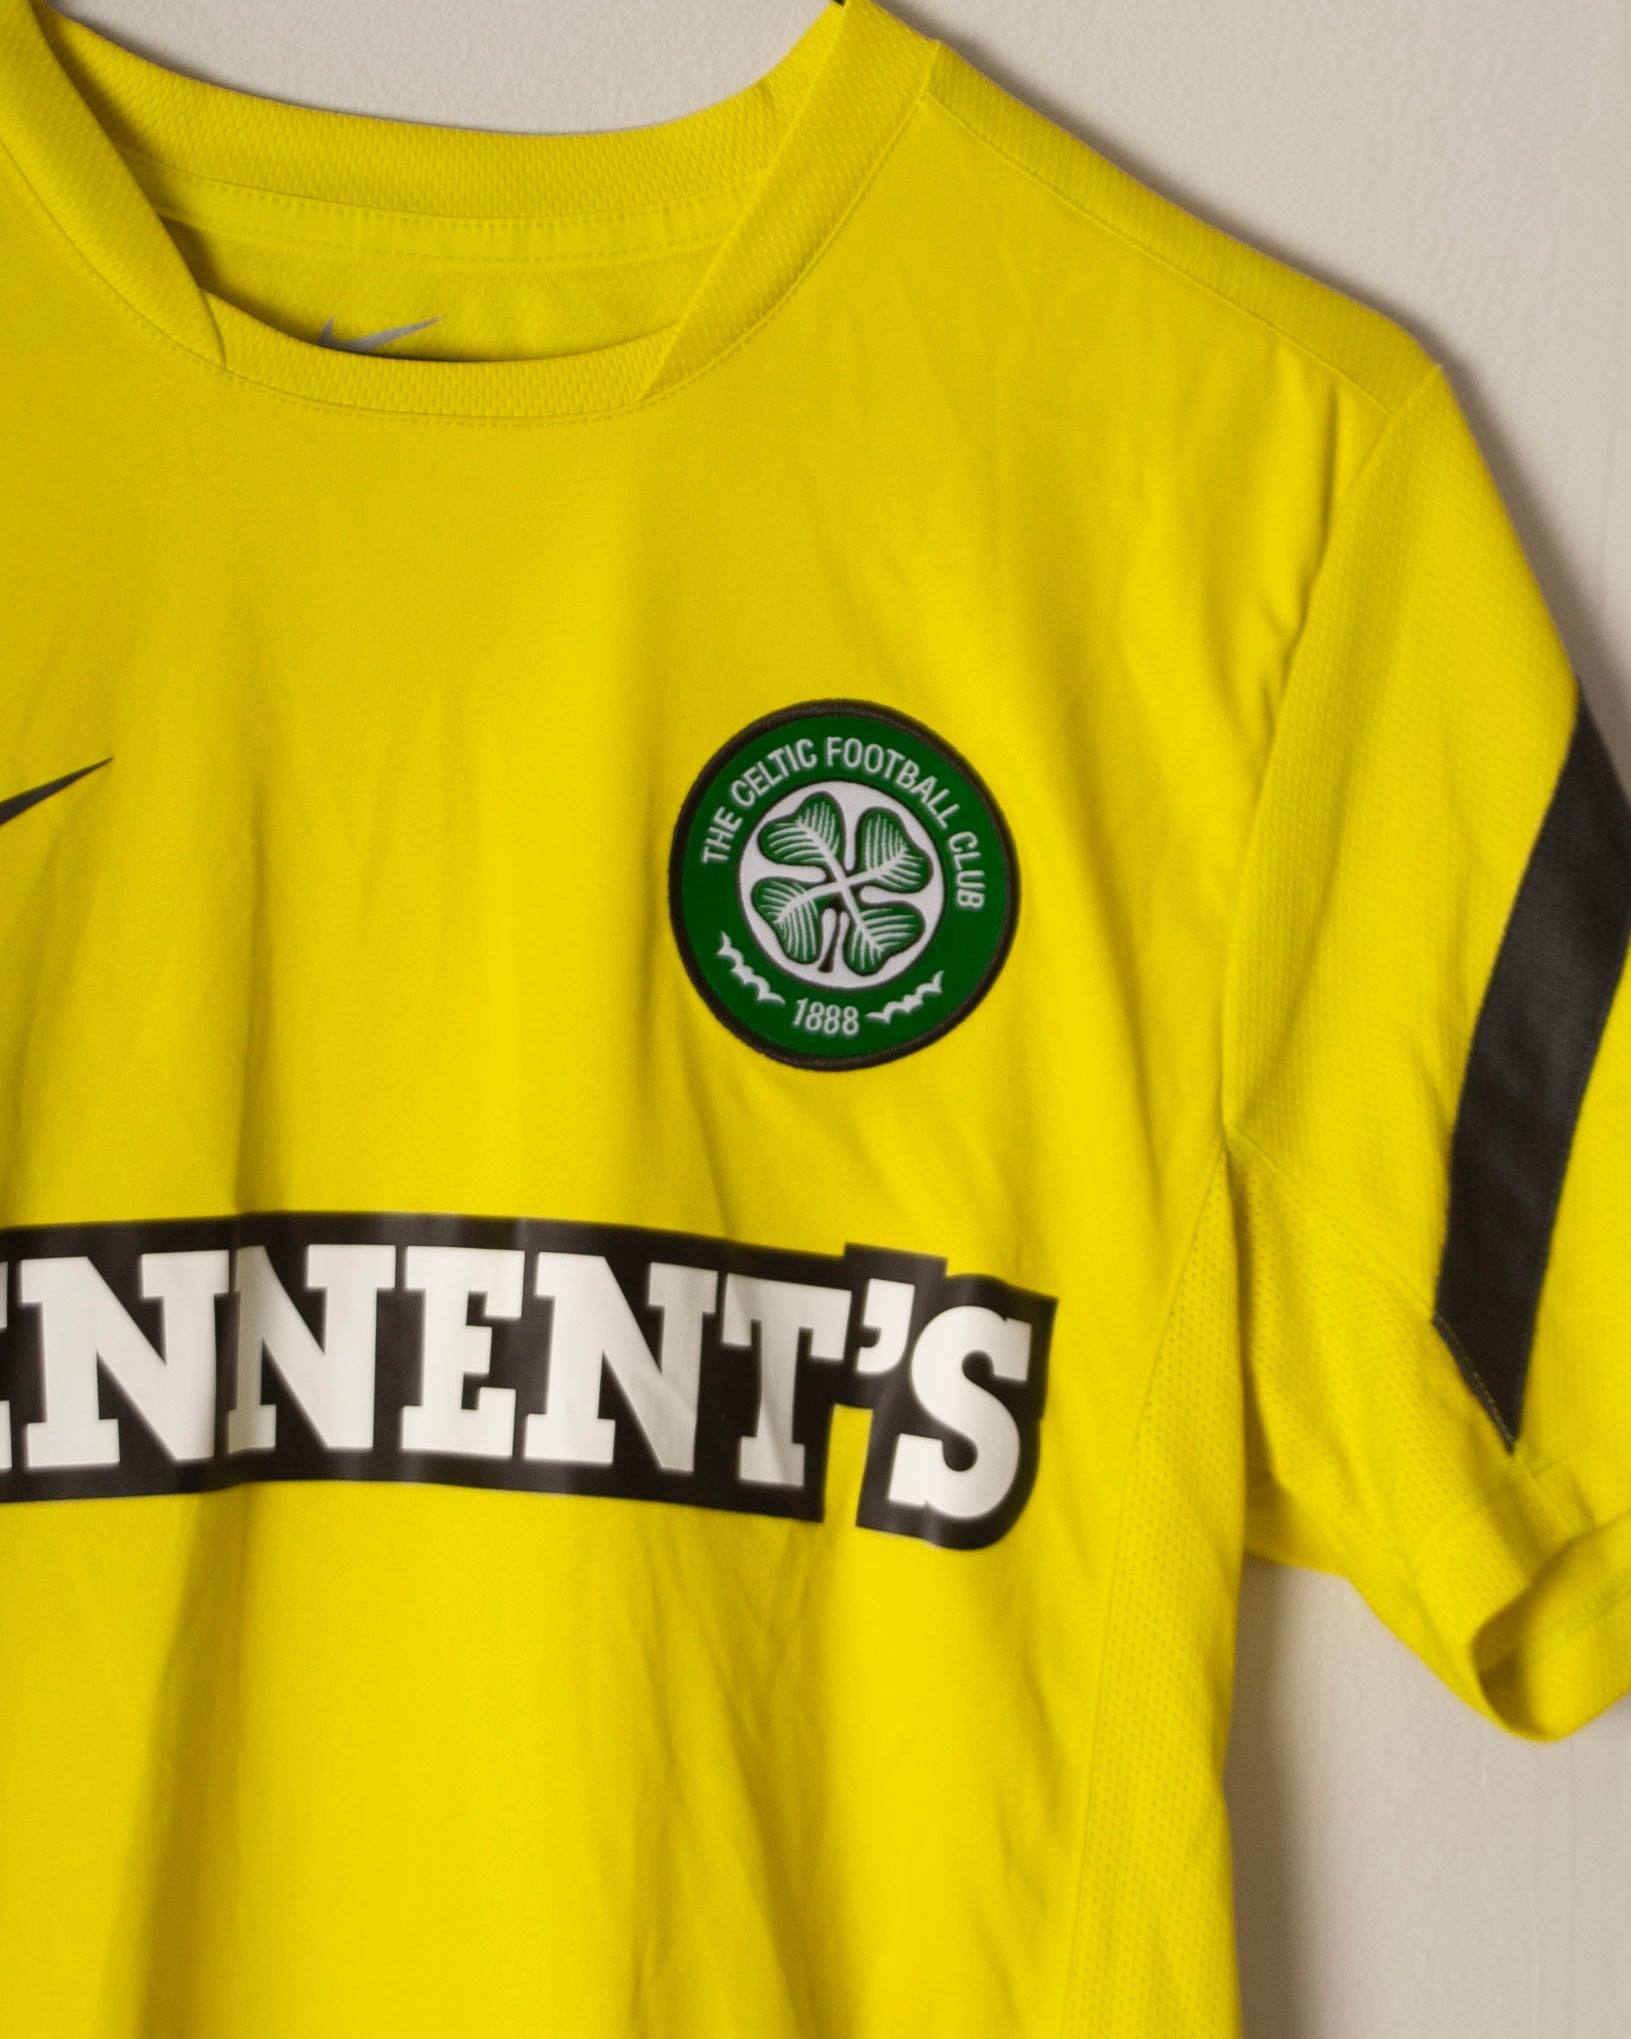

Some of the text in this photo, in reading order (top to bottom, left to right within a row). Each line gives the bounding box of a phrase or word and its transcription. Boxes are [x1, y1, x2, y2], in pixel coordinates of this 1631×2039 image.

[701, 737, 985, 910] THE CELTIC FOOTBALL CLUB
[792, 997, 860, 1036] 1888
[0, 1244, 1032, 1519] NNENT'S
